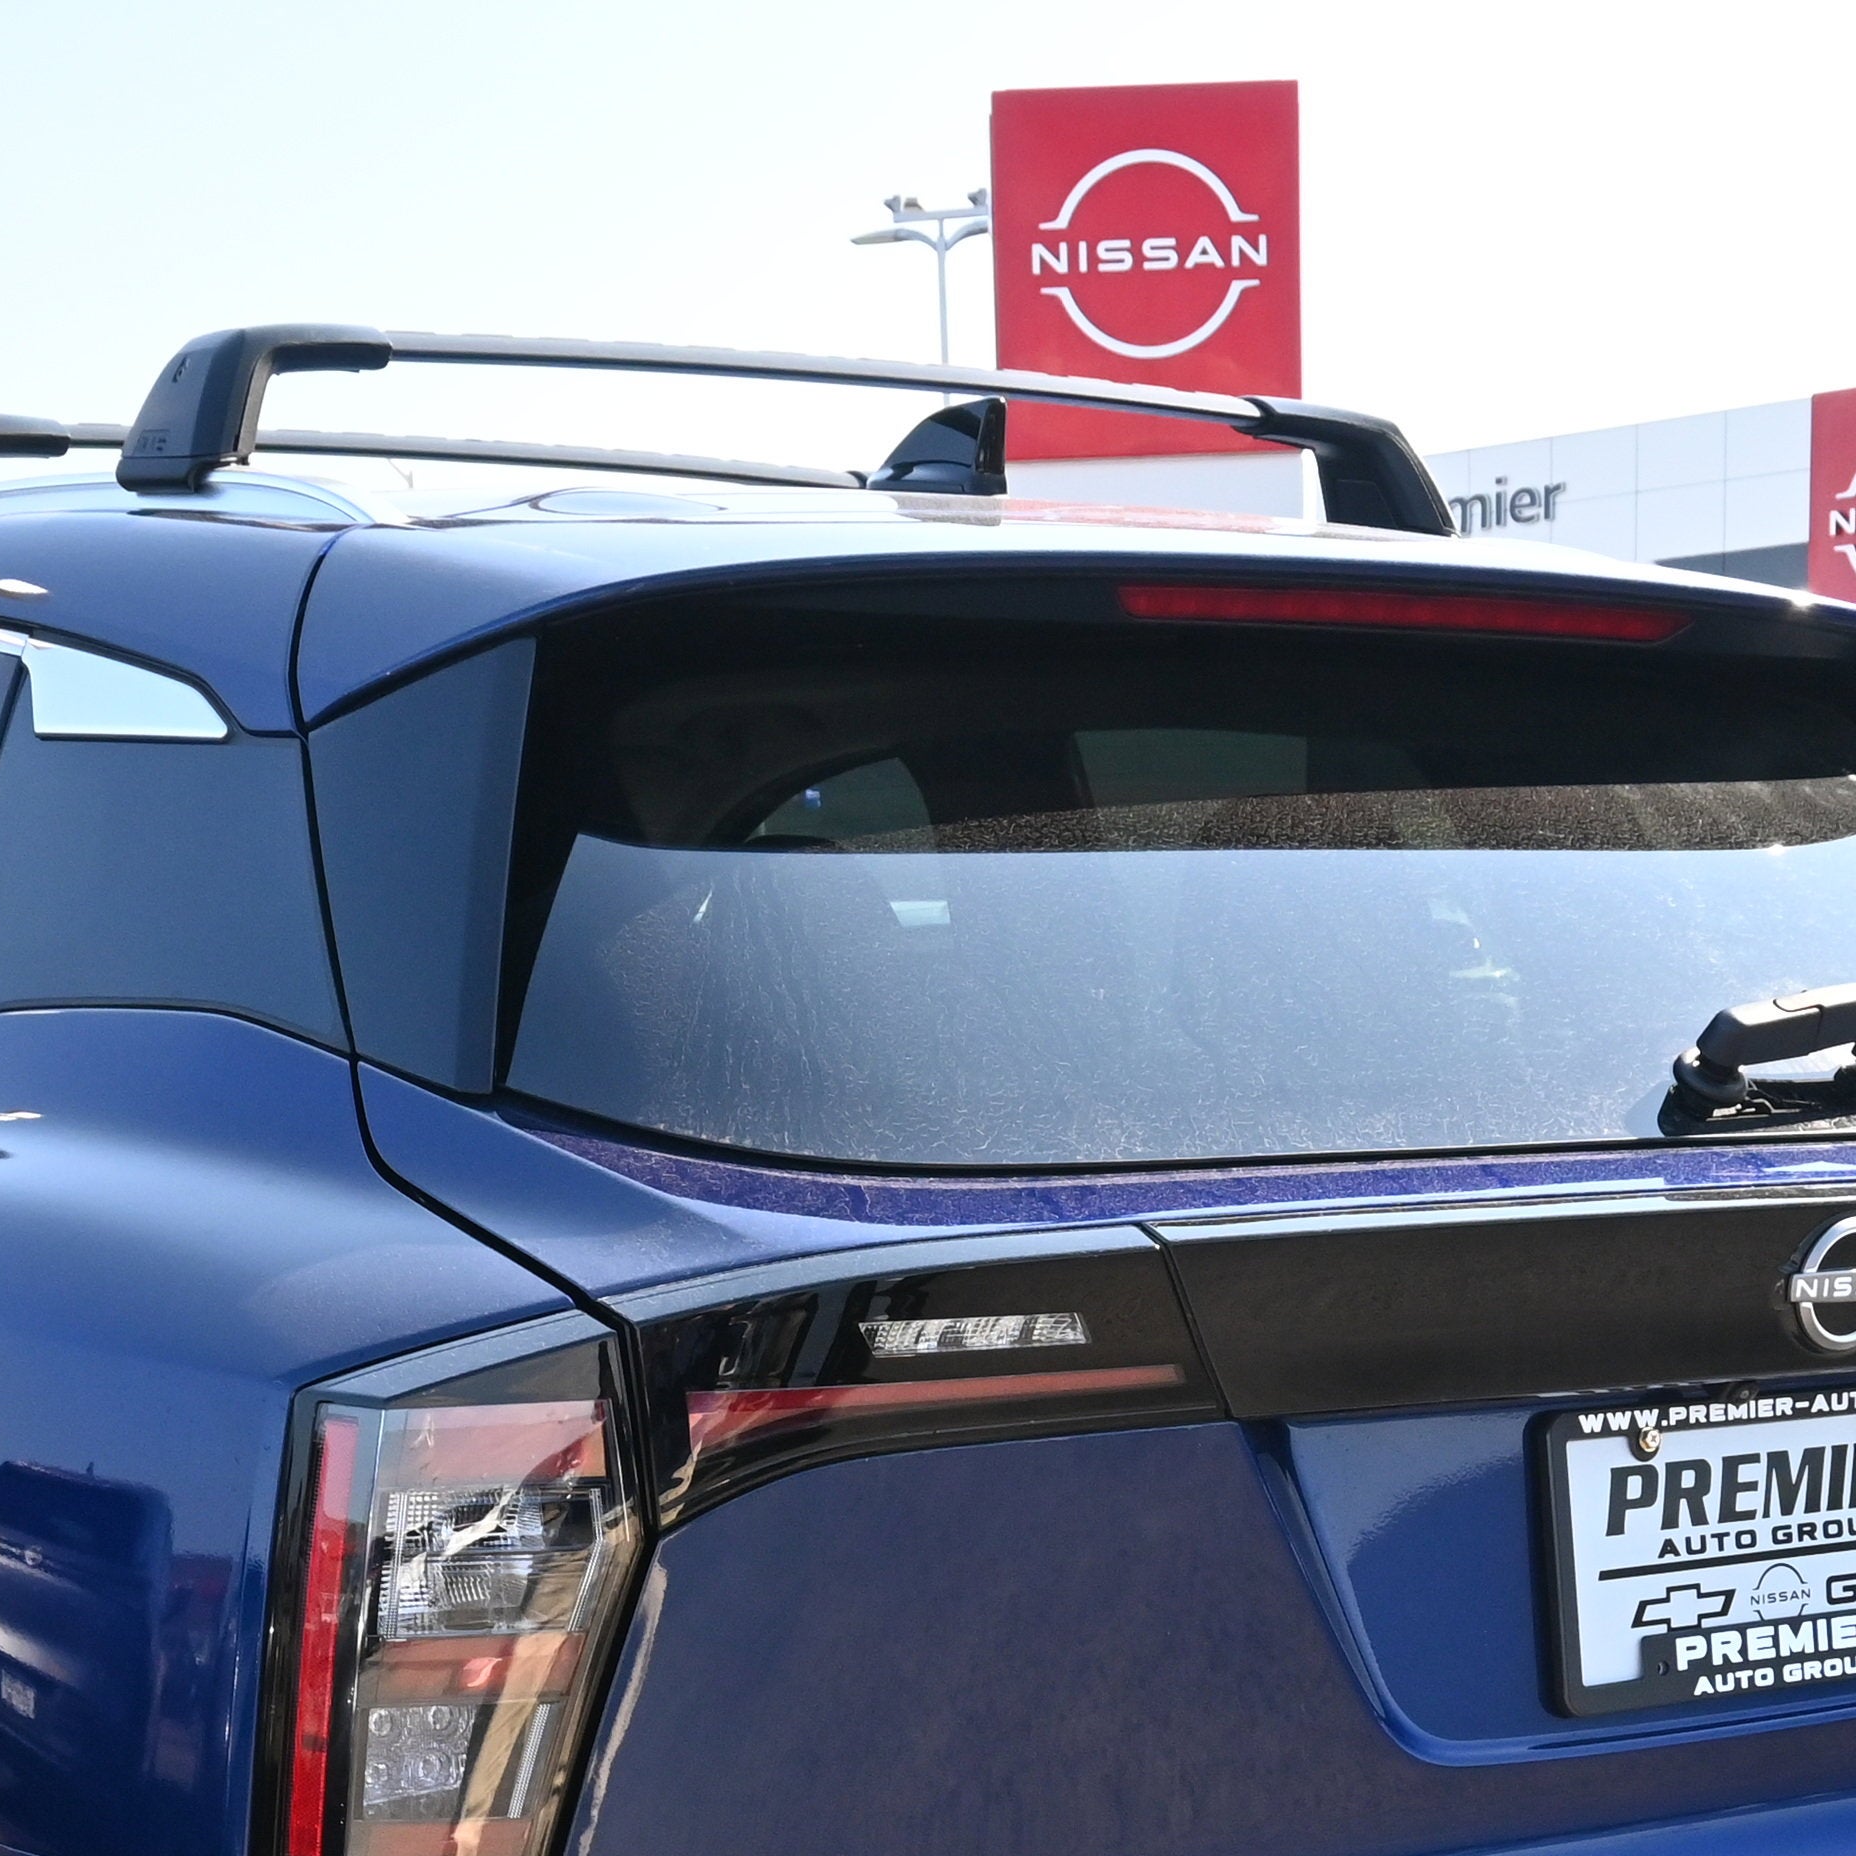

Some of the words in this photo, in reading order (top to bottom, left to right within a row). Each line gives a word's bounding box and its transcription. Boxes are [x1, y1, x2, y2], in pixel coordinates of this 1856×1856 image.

[1031, 233, 1268, 276] NISSAN
[1657, 1528, 1758, 1559] AUTO
[1750, 1588, 1812, 1607] NISSAN
[1693, 1667, 1775, 1696] AUTO
